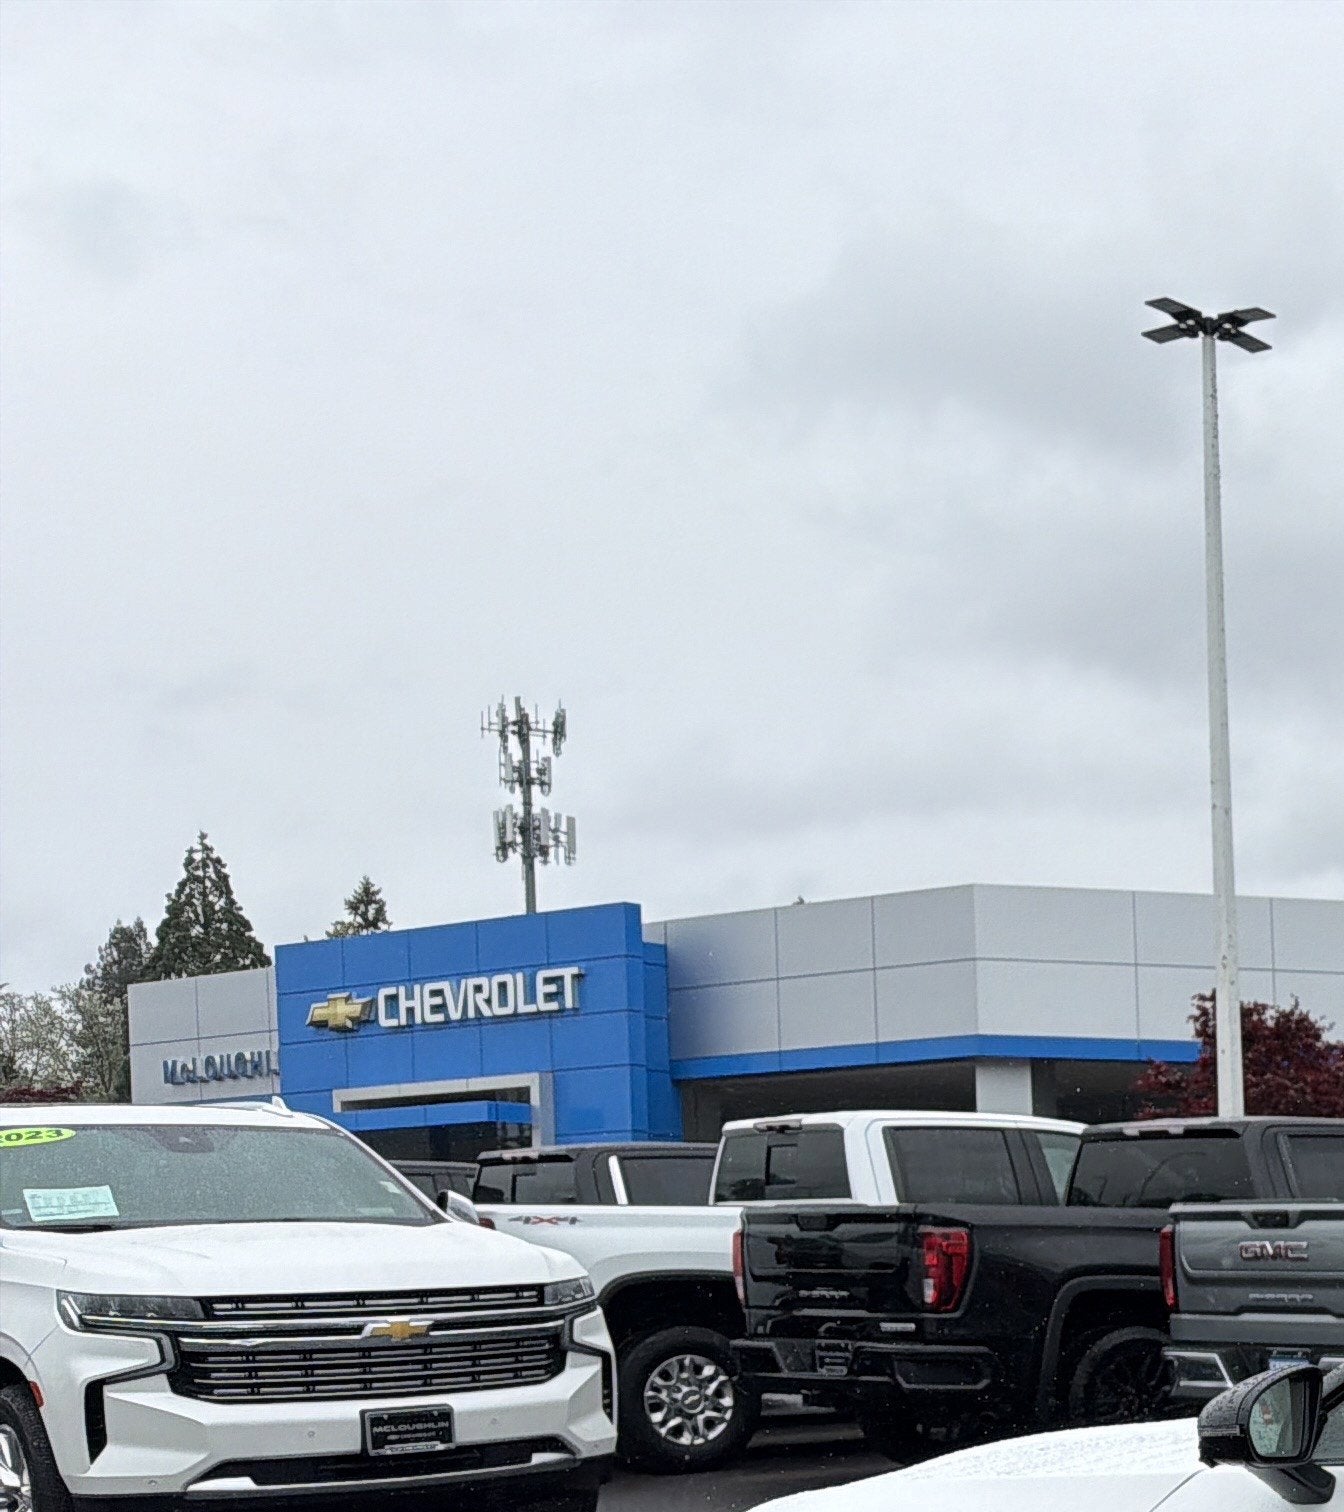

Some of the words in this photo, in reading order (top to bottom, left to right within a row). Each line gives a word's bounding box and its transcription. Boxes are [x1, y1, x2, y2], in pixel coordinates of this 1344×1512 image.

[377, 966, 582, 1027] CHEVROLET
[0, 1130, 64, 1143] 023
[1238, 1240, 1309, 1261] GMC
